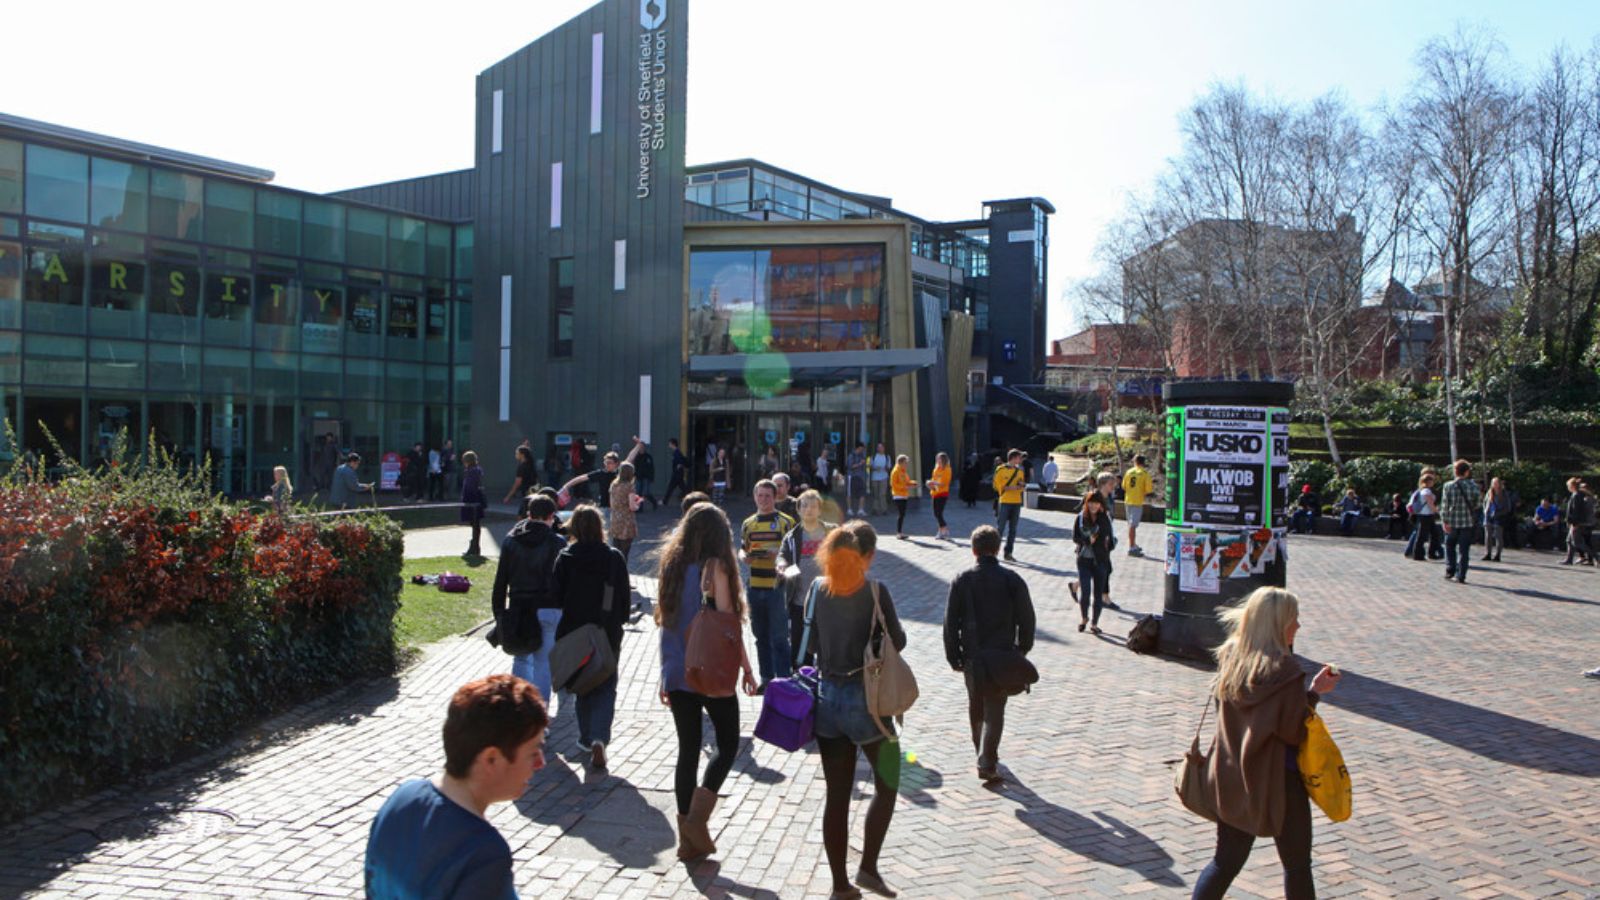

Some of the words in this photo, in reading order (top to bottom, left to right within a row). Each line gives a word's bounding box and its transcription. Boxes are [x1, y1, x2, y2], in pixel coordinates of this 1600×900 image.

[639, 32, 652, 101] Sheffield
[656, 30, 666, 75] Union
[640, 103, 650, 120] of
[636, 123, 653, 199] University
[1189, 433, 1262, 454] RUSKO
[1193, 468, 1254, 486] JAKWOB
